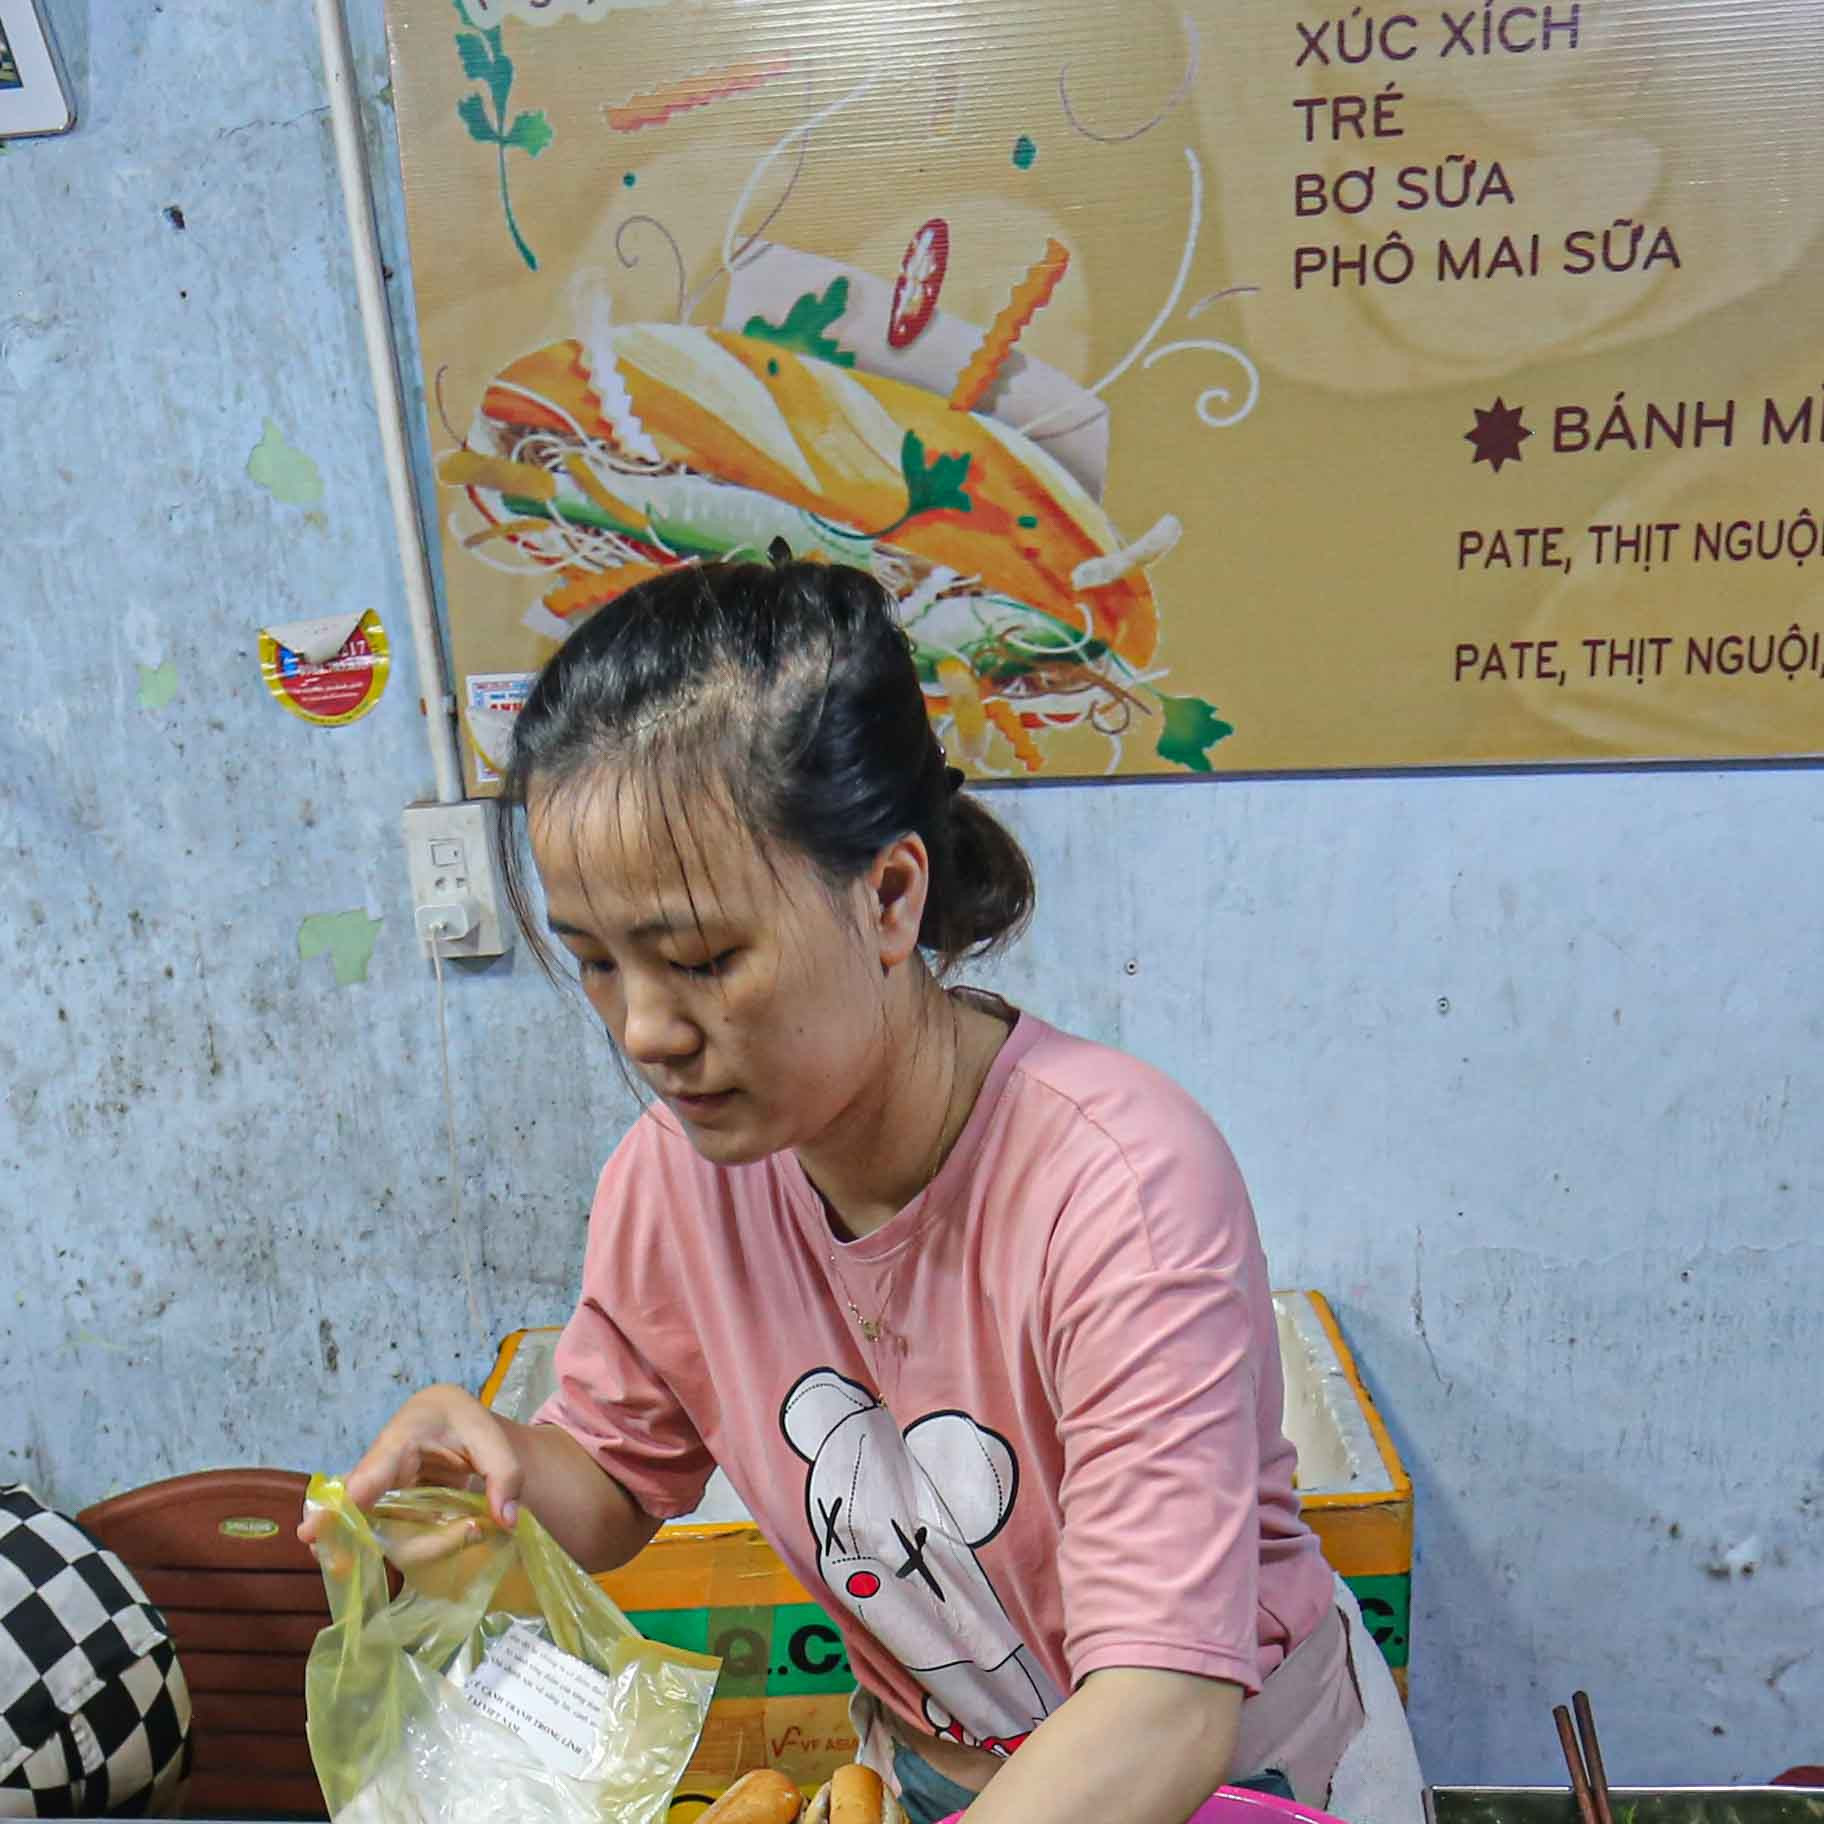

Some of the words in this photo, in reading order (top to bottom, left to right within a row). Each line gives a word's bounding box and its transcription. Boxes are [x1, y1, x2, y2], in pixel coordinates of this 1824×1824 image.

[1295, 5, 1418, 67] XÚC
[1439, 0, 1580, 58] XÍCH
[1292, 81, 1405, 142] TRÉ
[1295, 165, 1376, 217] BƠ
[1396, 154, 1515, 211] SỮA
[1294, 230, 1414, 290] PHÔ
[1437, 233, 1540, 282] MAI
[1563, 218, 1681, 275] SỮA
[1553, 391, 1735, 453] BÁNH
[1458, 527, 1572, 575] PATE,
[1587, 522, 1681, 573] THỊT
[1455, 640, 1566, 687] PATE,
[1581, 637, 1673, 685] THỊT
